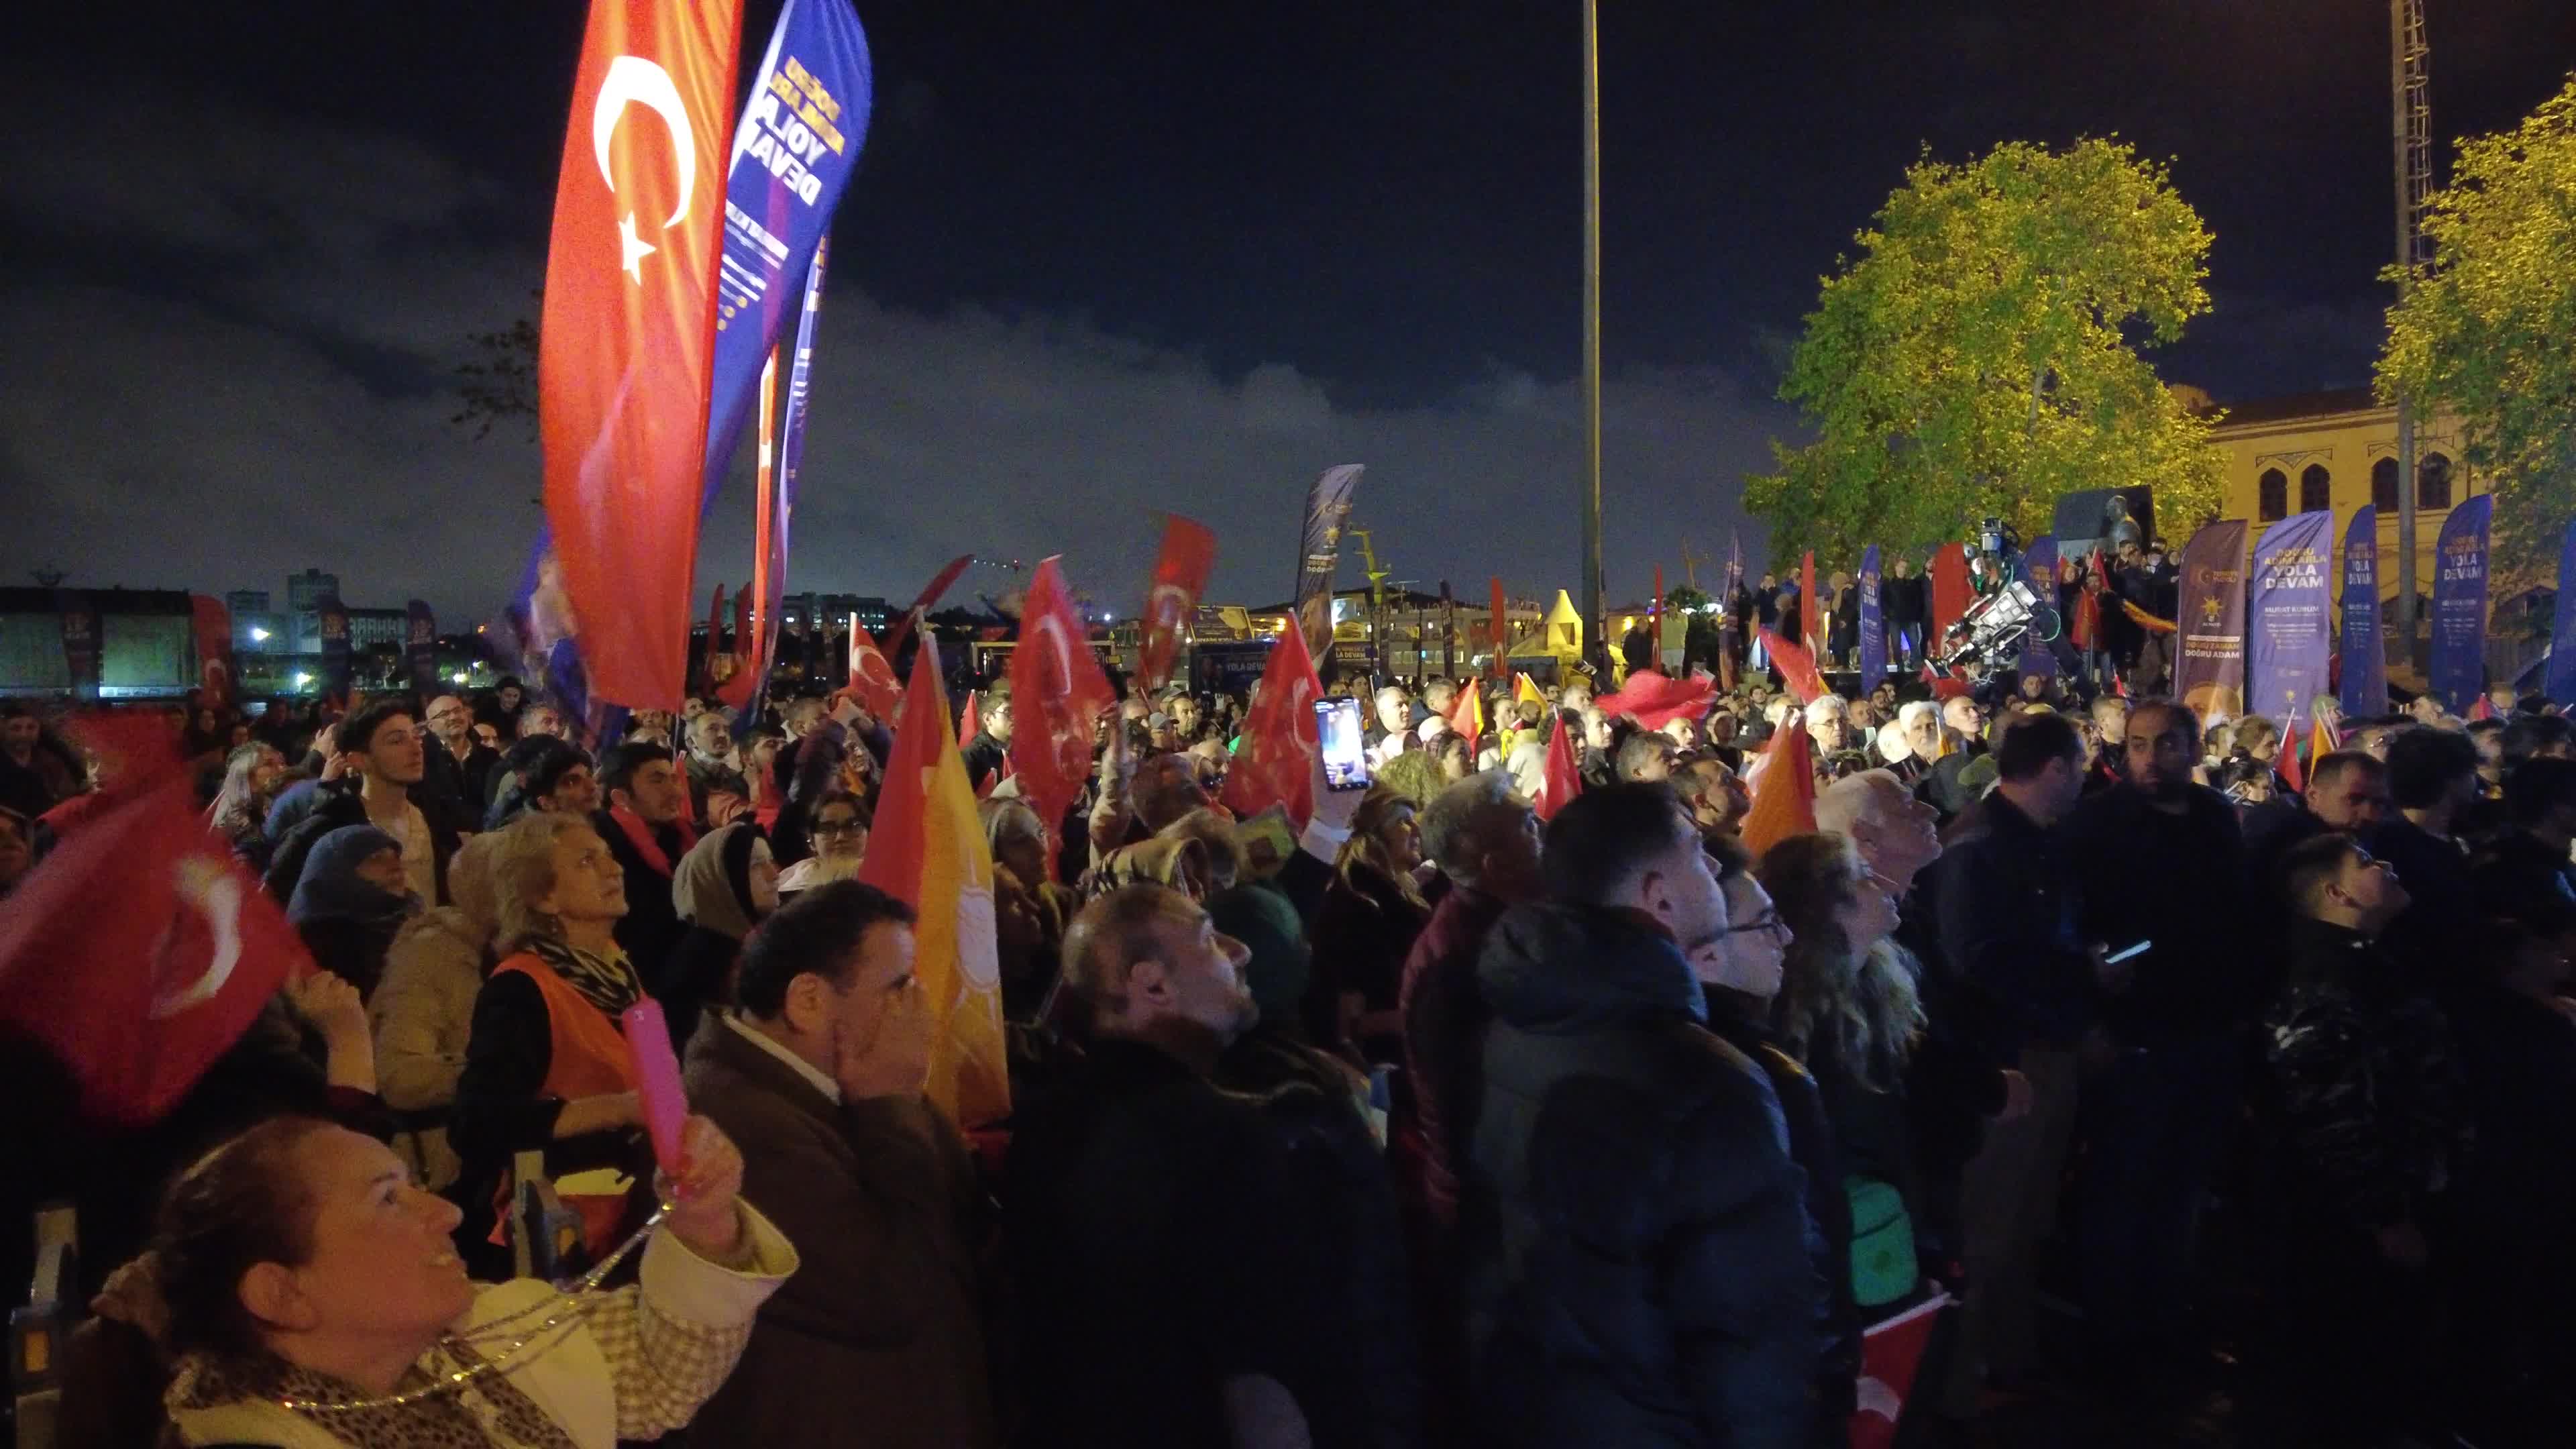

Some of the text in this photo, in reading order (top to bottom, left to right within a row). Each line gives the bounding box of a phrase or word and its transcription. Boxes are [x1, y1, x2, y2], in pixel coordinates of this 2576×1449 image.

[2451, 553, 2477, 566] YOLA
[2273, 565, 2316, 576] YOLA
[2444, 566, 2481, 580] DEVAM
[2265, 576, 2324, 589] DEVAM
[2349, 573, 2372, 585] DEVAM
[2185, 649, 2240, 659] DOĞRU ADAM
[1246, 661, 1267, 671] DEVA
